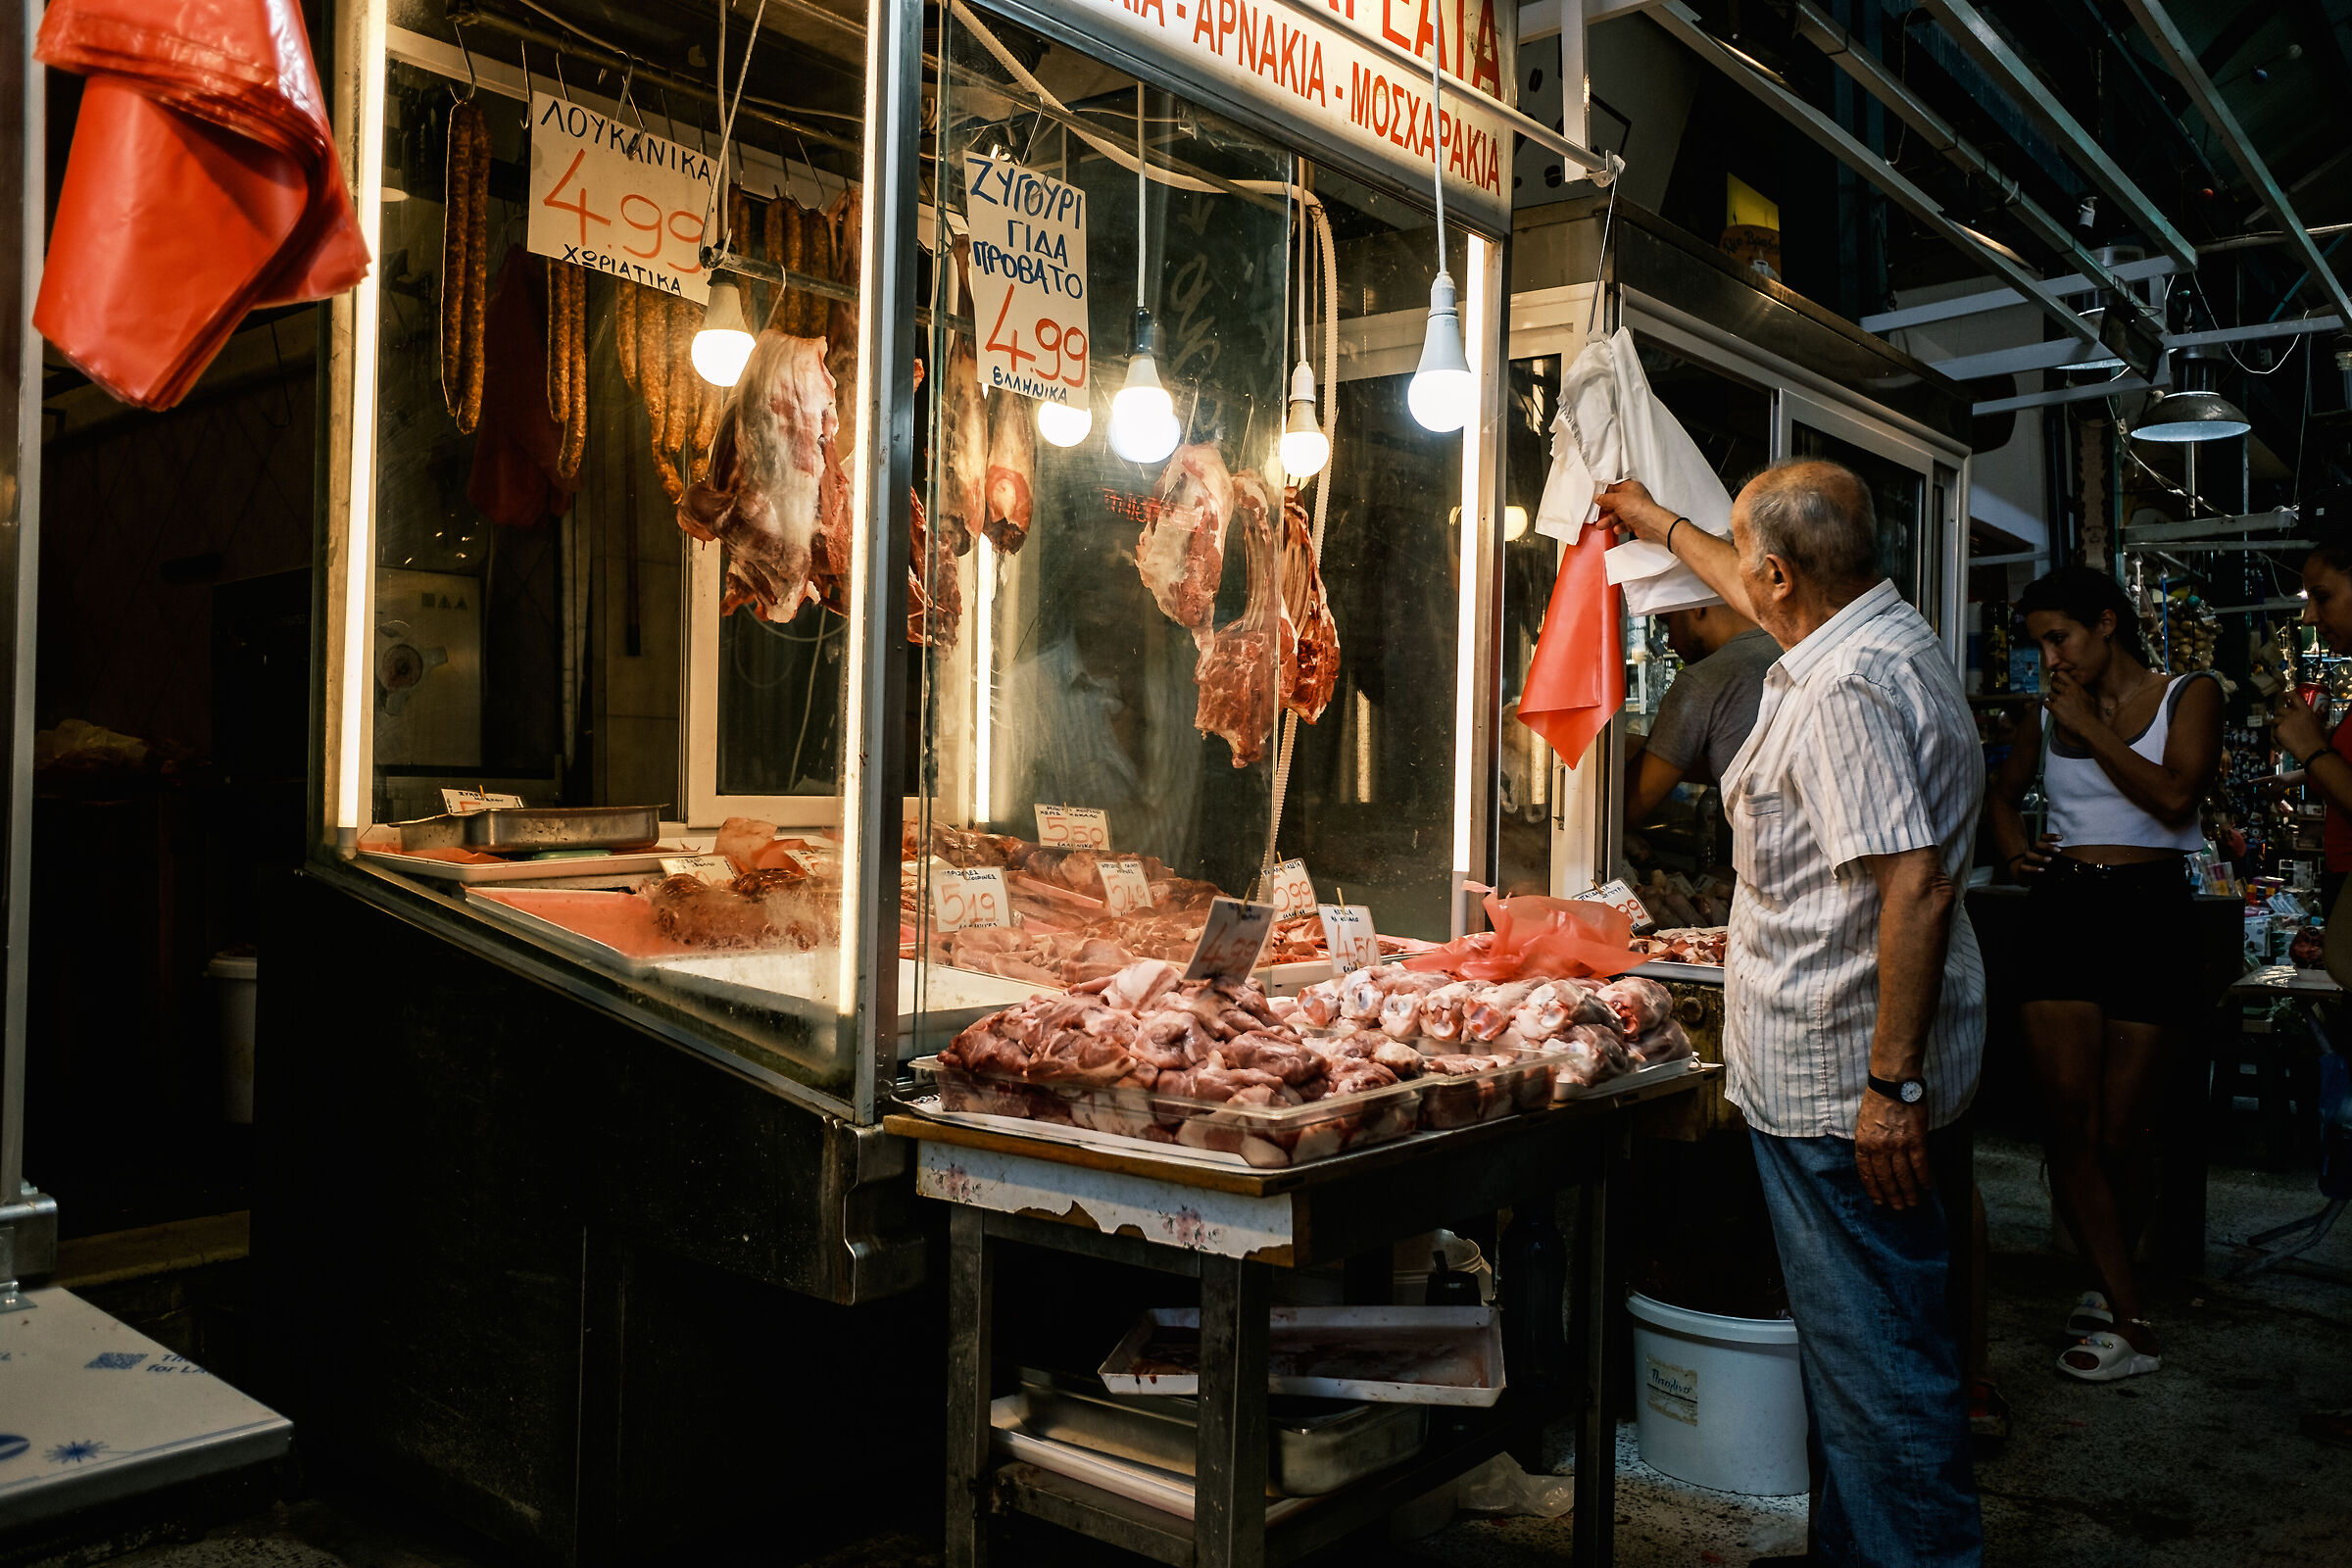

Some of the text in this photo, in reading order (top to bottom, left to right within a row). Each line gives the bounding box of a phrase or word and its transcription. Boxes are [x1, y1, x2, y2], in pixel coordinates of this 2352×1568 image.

[1193, 0, 1326, 108] ΑΡΝΑΚΙΑ
[1350, 61, 1500, 197] ΜΟΣΧΑΡΑΚΙΑ
[540, 100, 711, 187] ΛΟΥΚΑΝΙΚΑ
[965, 157, 1082, 230] ΖΥΓΟΥΡΙ
[973, 241, 1083, 299] ΠΡΟΒΑΤΟ
[1007, 219, 1068, 268] ΓΙΔΑ
[993, 366, 1068, 405] ΕΛΛΗΝΙΚΑ
[146, 1363, 177, 1373] for
